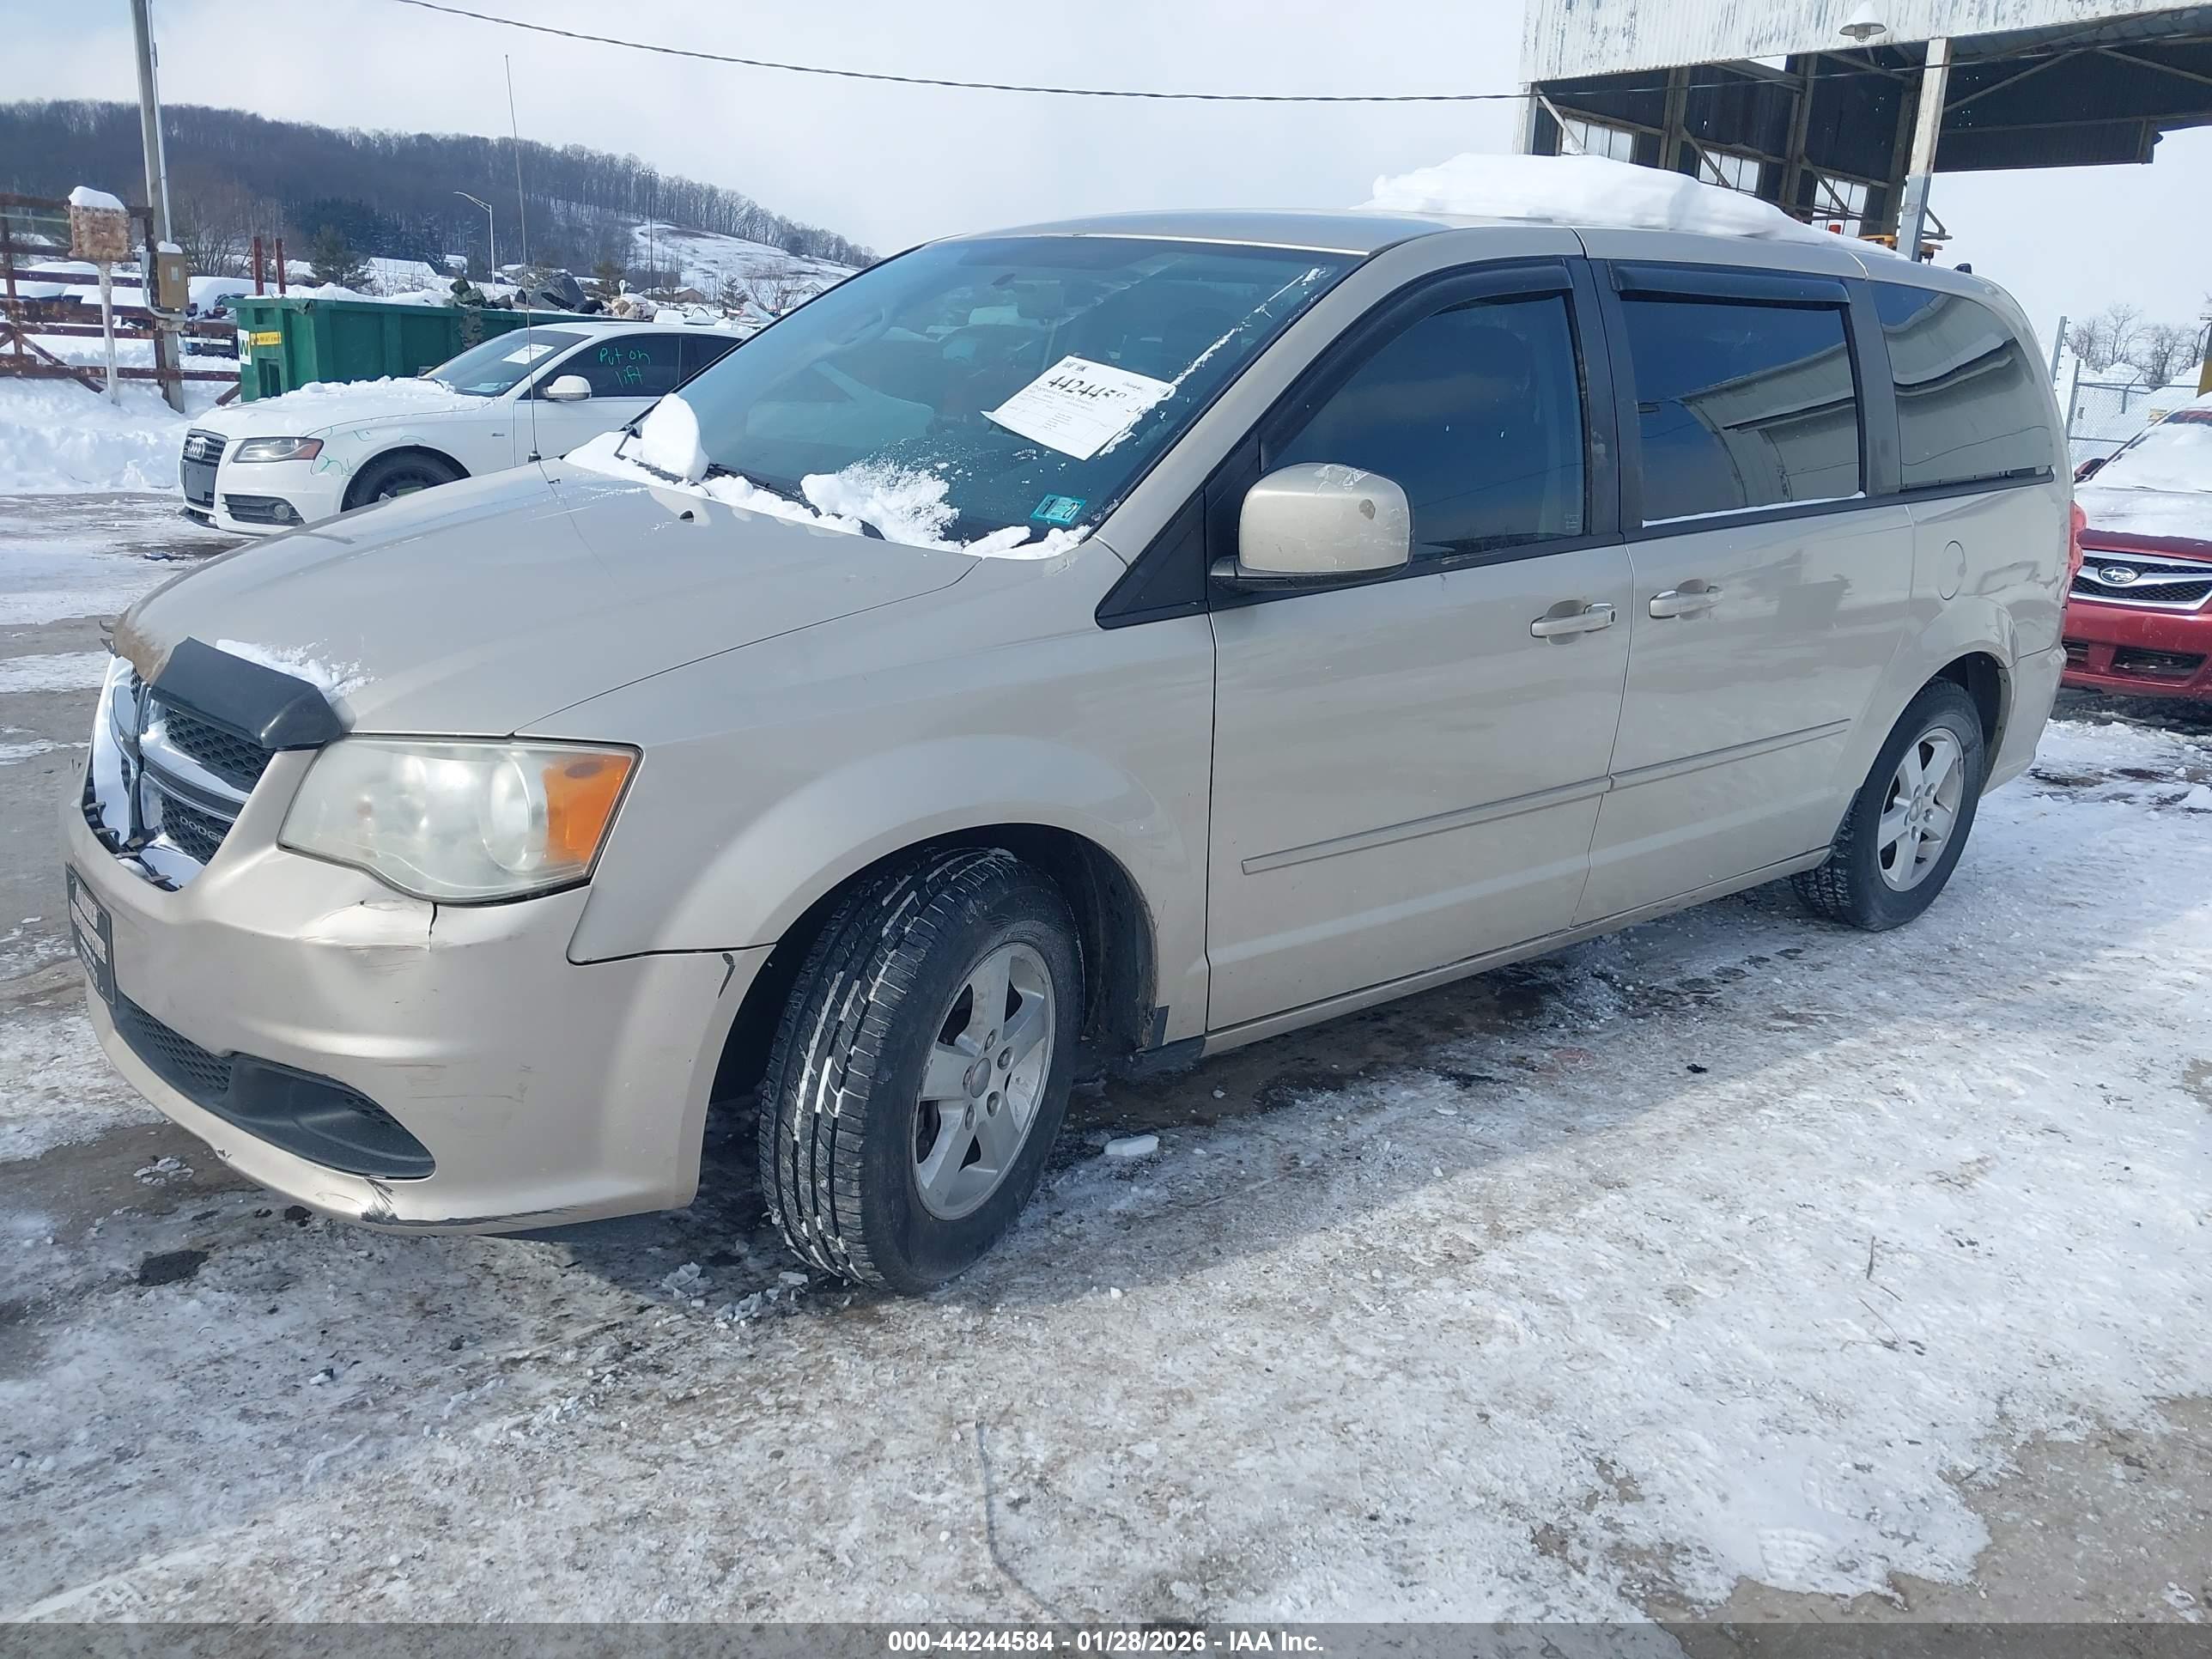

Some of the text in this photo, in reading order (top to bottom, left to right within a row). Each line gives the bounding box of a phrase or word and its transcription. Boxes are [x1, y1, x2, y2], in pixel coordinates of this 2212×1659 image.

[599, 347, 651, 365] Put on
[615, 365, 644, 387] lift
